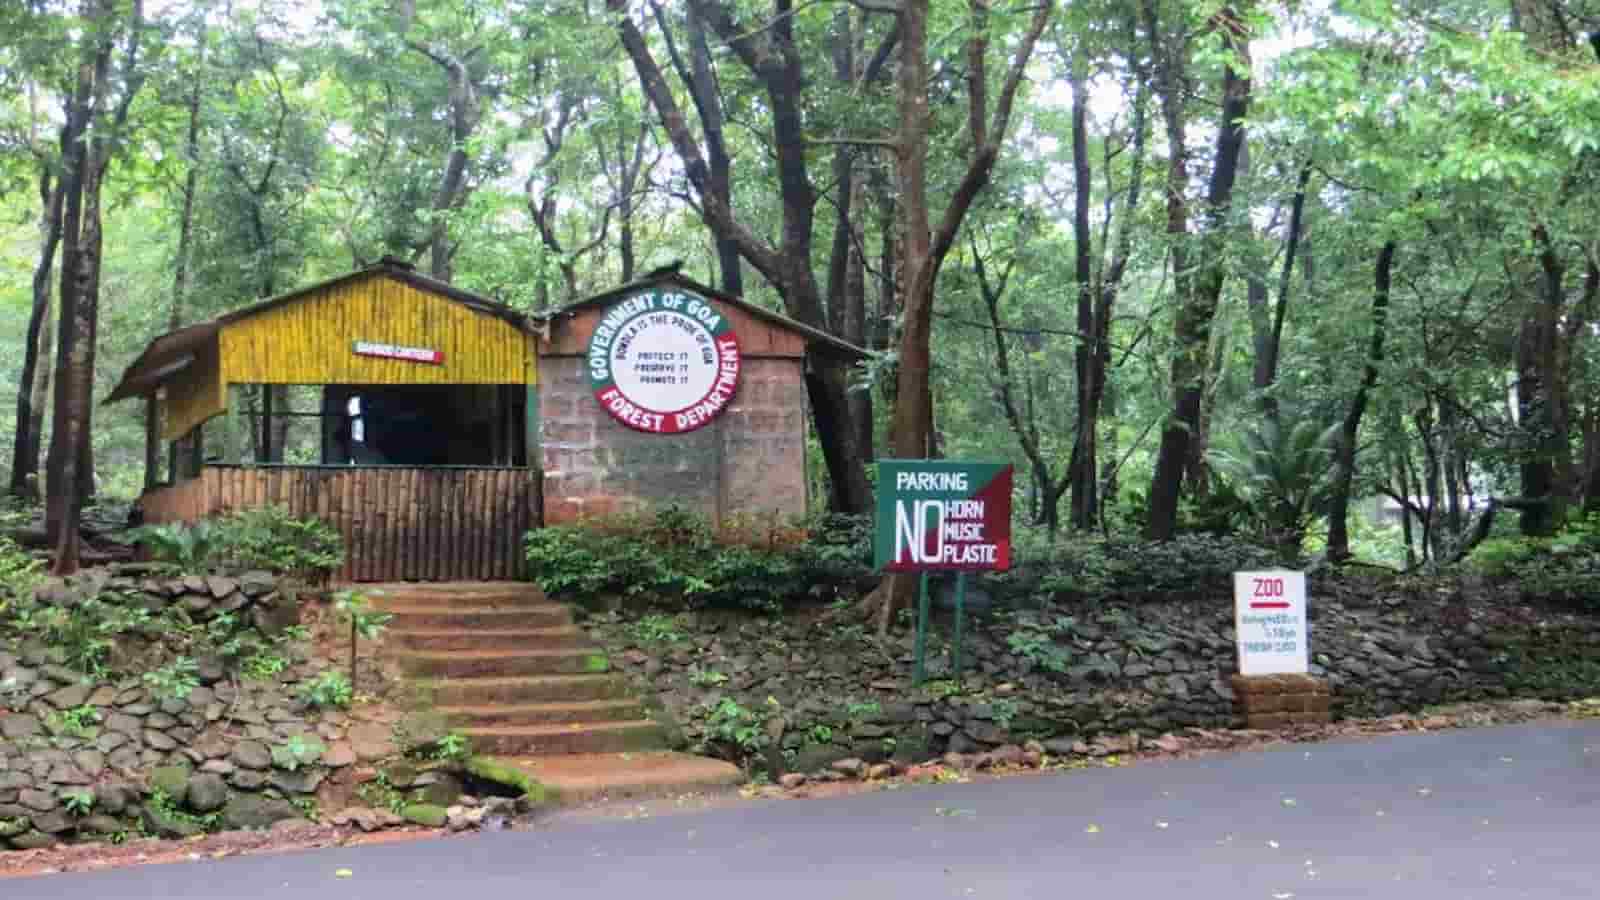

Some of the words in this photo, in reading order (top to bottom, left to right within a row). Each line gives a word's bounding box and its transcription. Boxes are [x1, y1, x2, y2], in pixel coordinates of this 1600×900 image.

[637, 318, 648, 330] IS
[649, 314, 669, 325] THE
[671, 316, 698, 335] PRIDE
[589, 293, 656, 380] GOVERNMENT
[662, 293, 687, 309] OF
[687, 301, 721, 331] GOA
[637, 352, 675, 361] PROTECT
[679, 352, 689, 361] IT
[679, 364, 689, 372] IT
[600, 389, 665, 431] FOREST
[675, 340, 740, 430] DEPARTMENT
[639, 376, 676, 384] PROMOTE
[680, 376, 689, 384] IT
[896, 472, 969, 491] PARKING
[944, 500, 985, 519] HORN
[895, 499, 944, 563] NO
[944, 522, 985, 541] MUSIC
[943, 544, 999, 563] PLASTIC
[1253, 578, 1284, 597] ZOO
